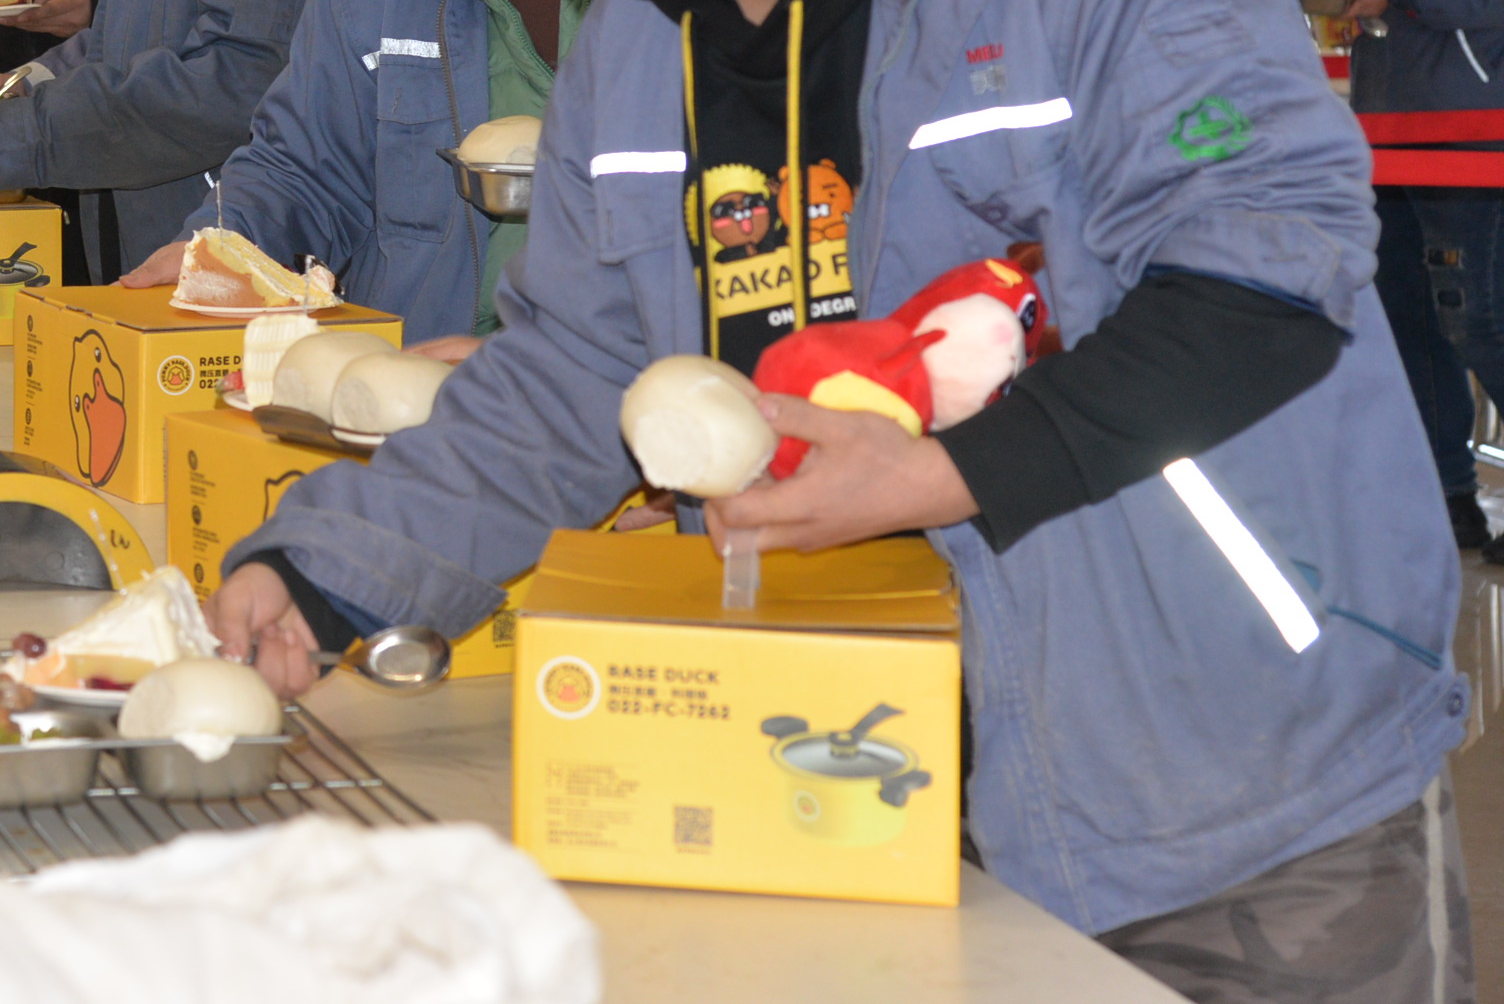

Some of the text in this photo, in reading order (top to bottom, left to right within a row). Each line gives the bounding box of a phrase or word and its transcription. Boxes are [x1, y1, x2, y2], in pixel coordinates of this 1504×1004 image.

[199, 356, 230, 366] RASE
[664, 667, 719, 684] DUCK
[607, 699, 731, 721] 022-FC-7262
